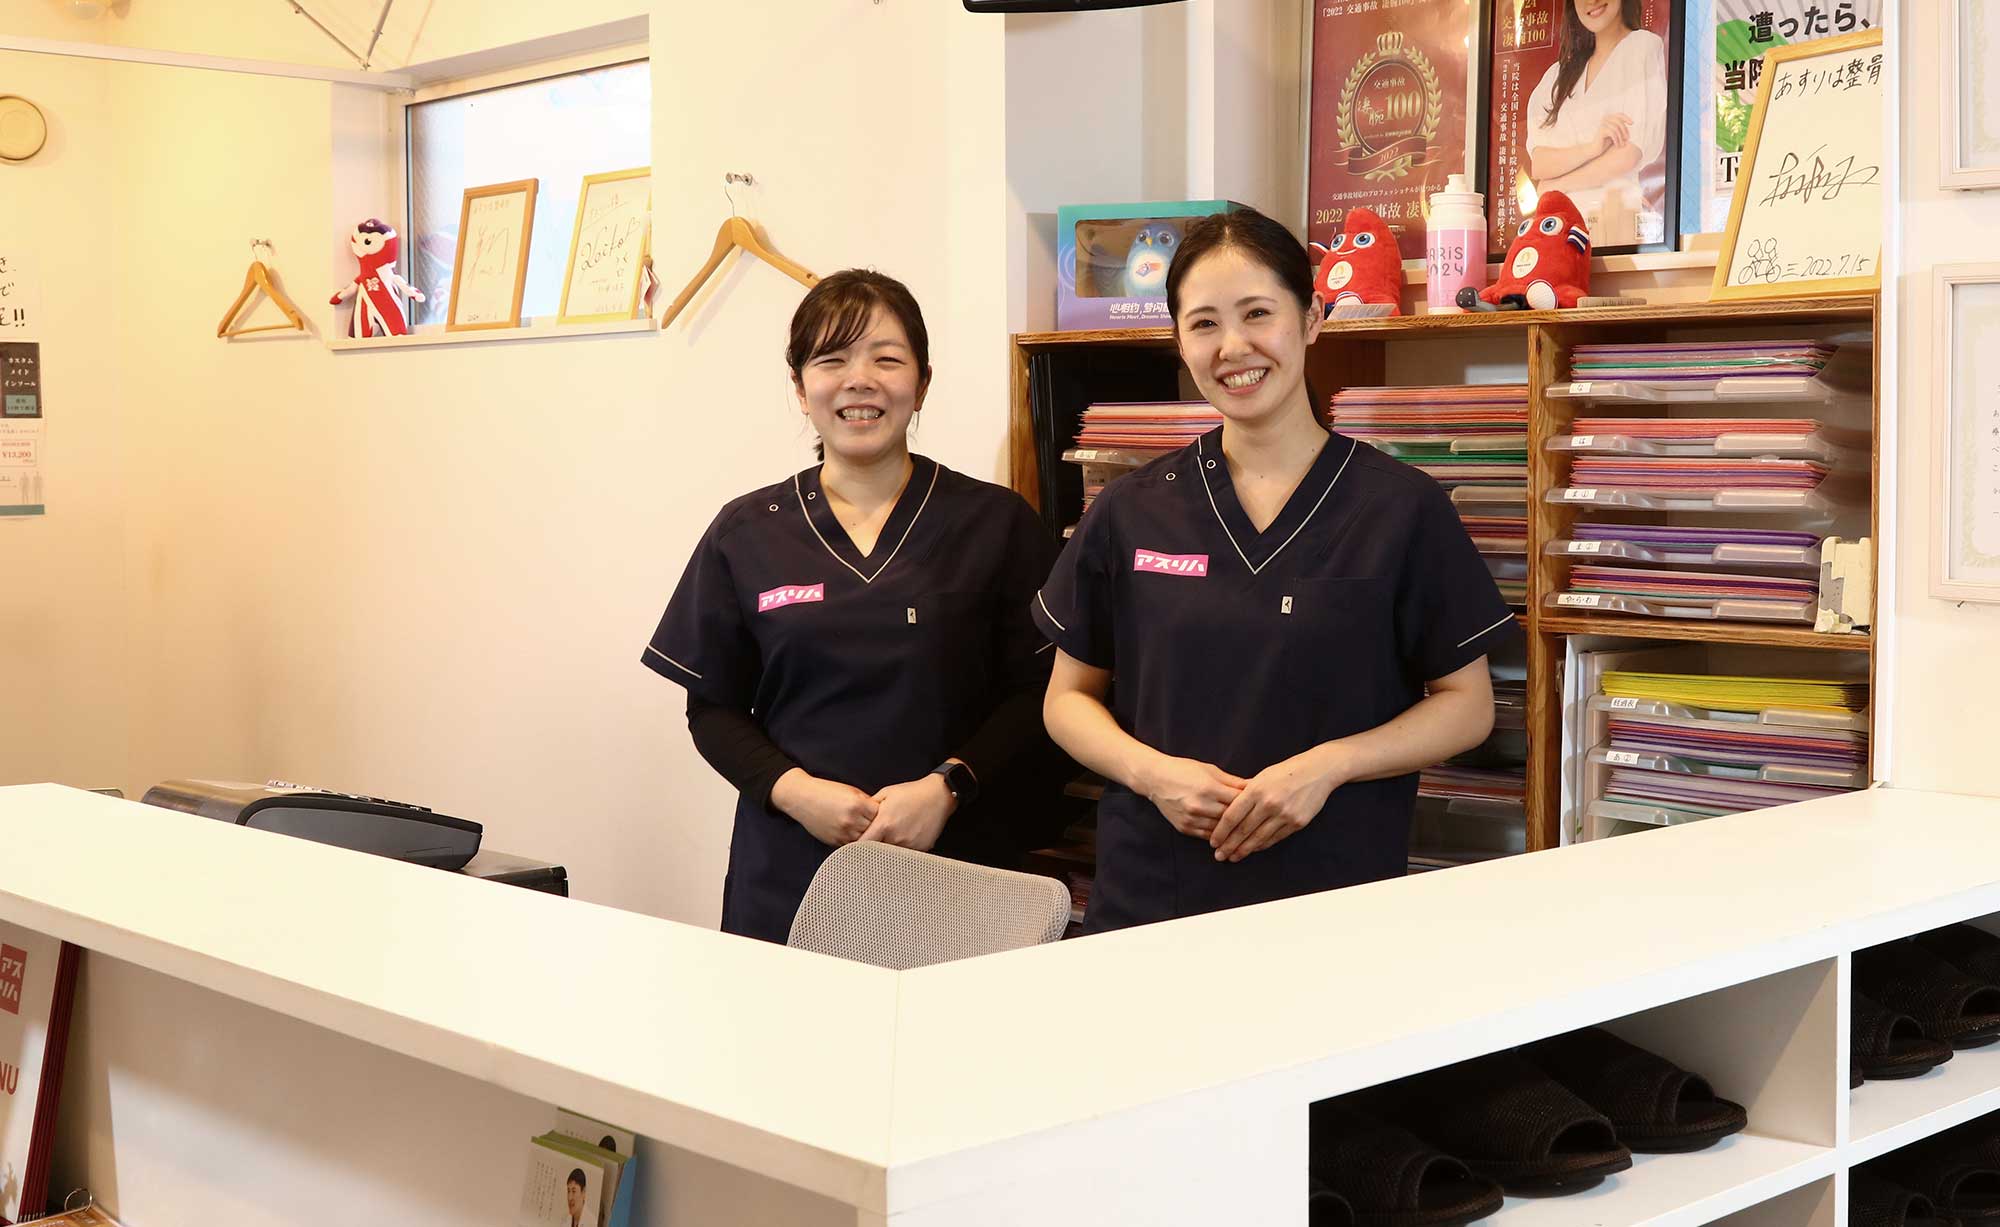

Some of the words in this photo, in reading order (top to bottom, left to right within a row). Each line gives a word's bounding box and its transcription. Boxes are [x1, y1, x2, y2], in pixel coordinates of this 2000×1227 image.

[1503, 10, 1548, 30] 交事故
[1748, 2, 1871, 44] 遭ったら、
[1386, 90, 1421, 121] 100
[1720, 156, 1739, 183] T
[1316, 207, 1343, 225] 2022
